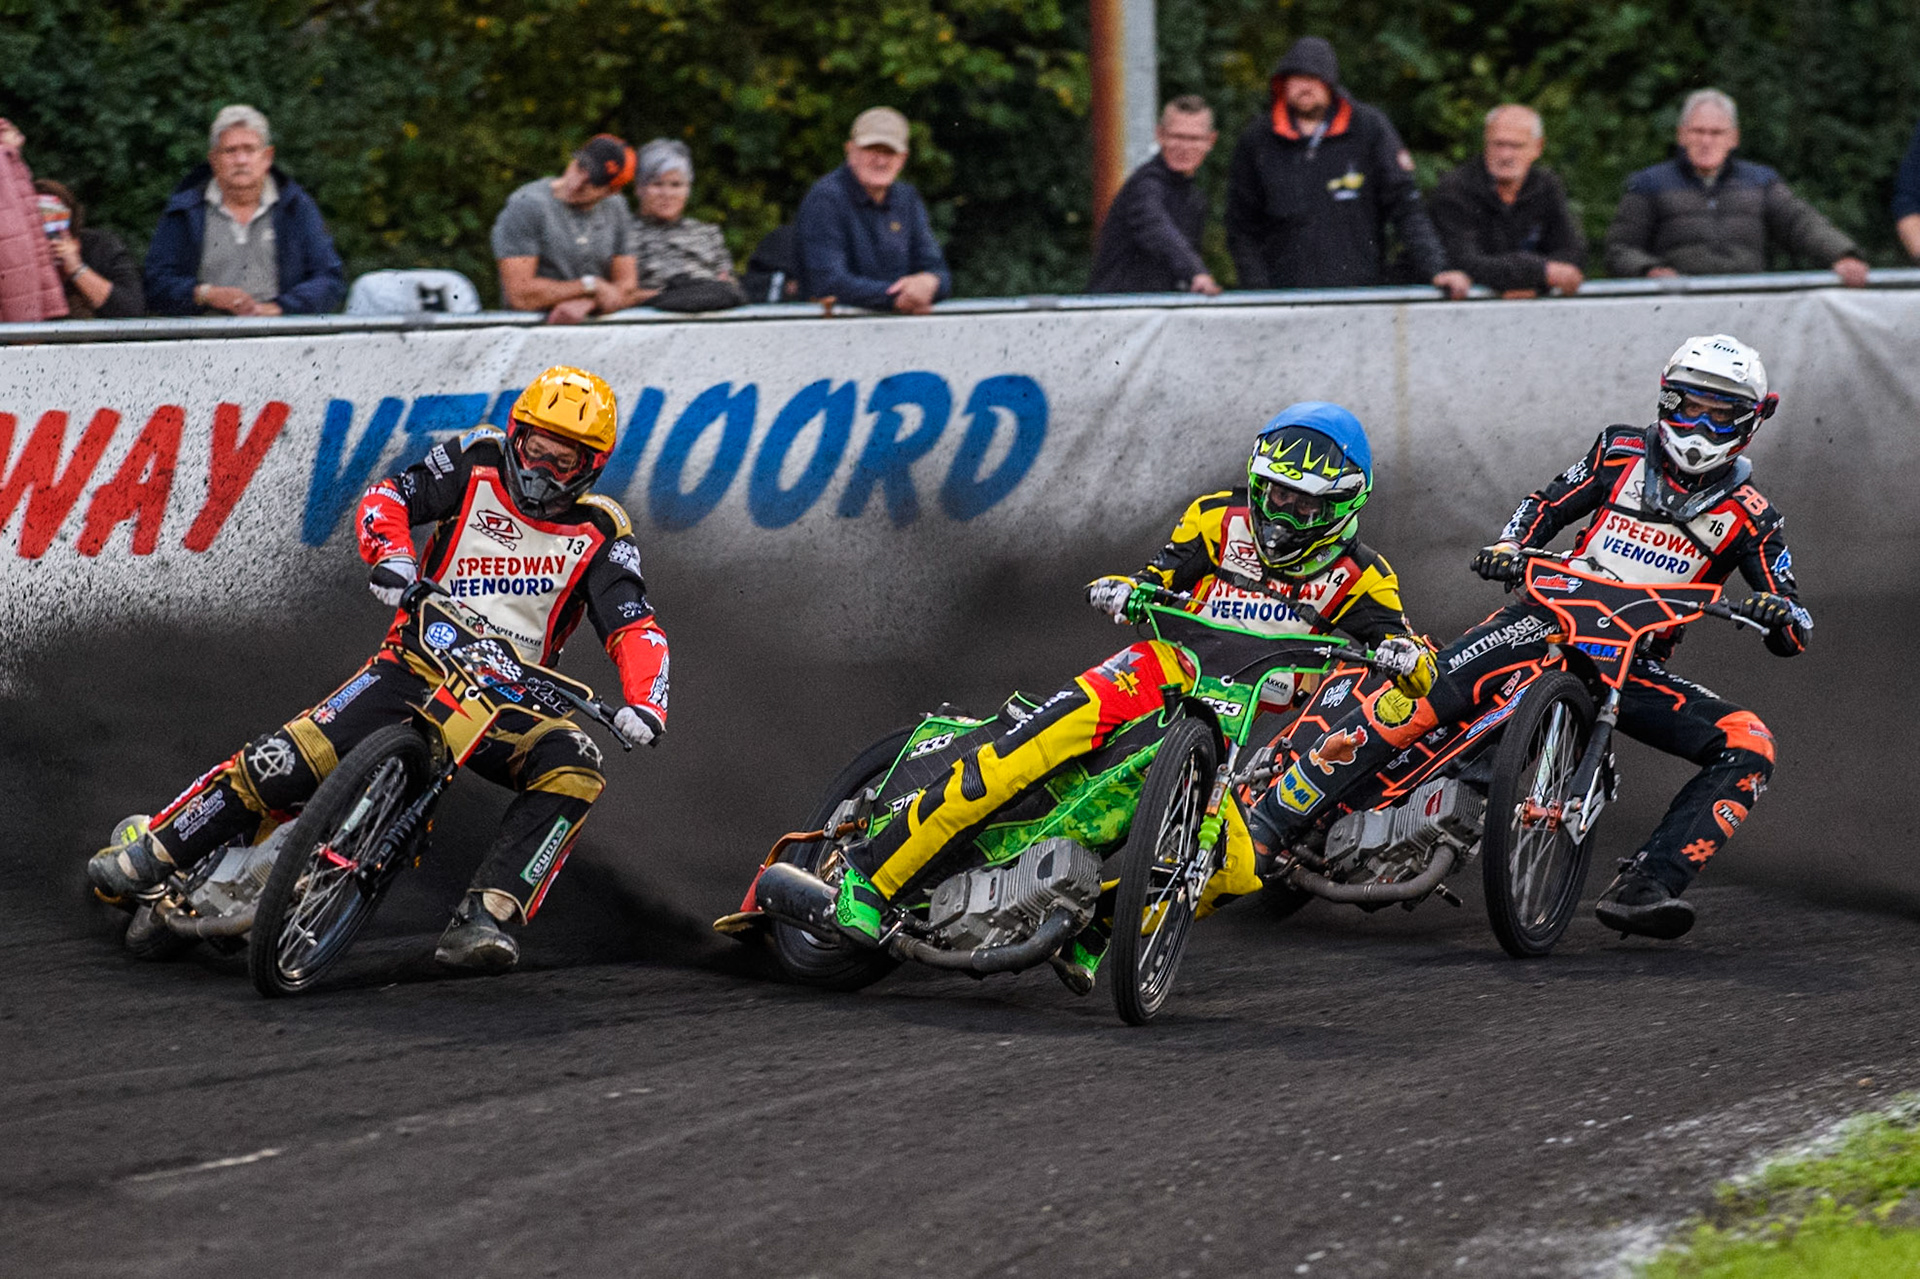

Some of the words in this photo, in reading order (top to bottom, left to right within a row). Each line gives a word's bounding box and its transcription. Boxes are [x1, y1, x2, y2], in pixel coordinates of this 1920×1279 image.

[0, 400, 292, 559] WAY
[299, 370, 1049, 547] VOORD
[1708, 519, 1725, 537] 16
[566, 537, 586, 556] 13
[1602, 535, 1691, 575] VEENOORD
[457, 555, 567, 577] SPEEDWAY
[450, 577, 555, 597] VEENOORD
[1326, 568, 1346, 588] 14
[1448, 615, 1544, 670] MATTHIJSSEN
[1264, 676, 1289, 691] AKKER
[910, 732, 955, 759] 333
[1283, 772, 1311, 806] WD-40
